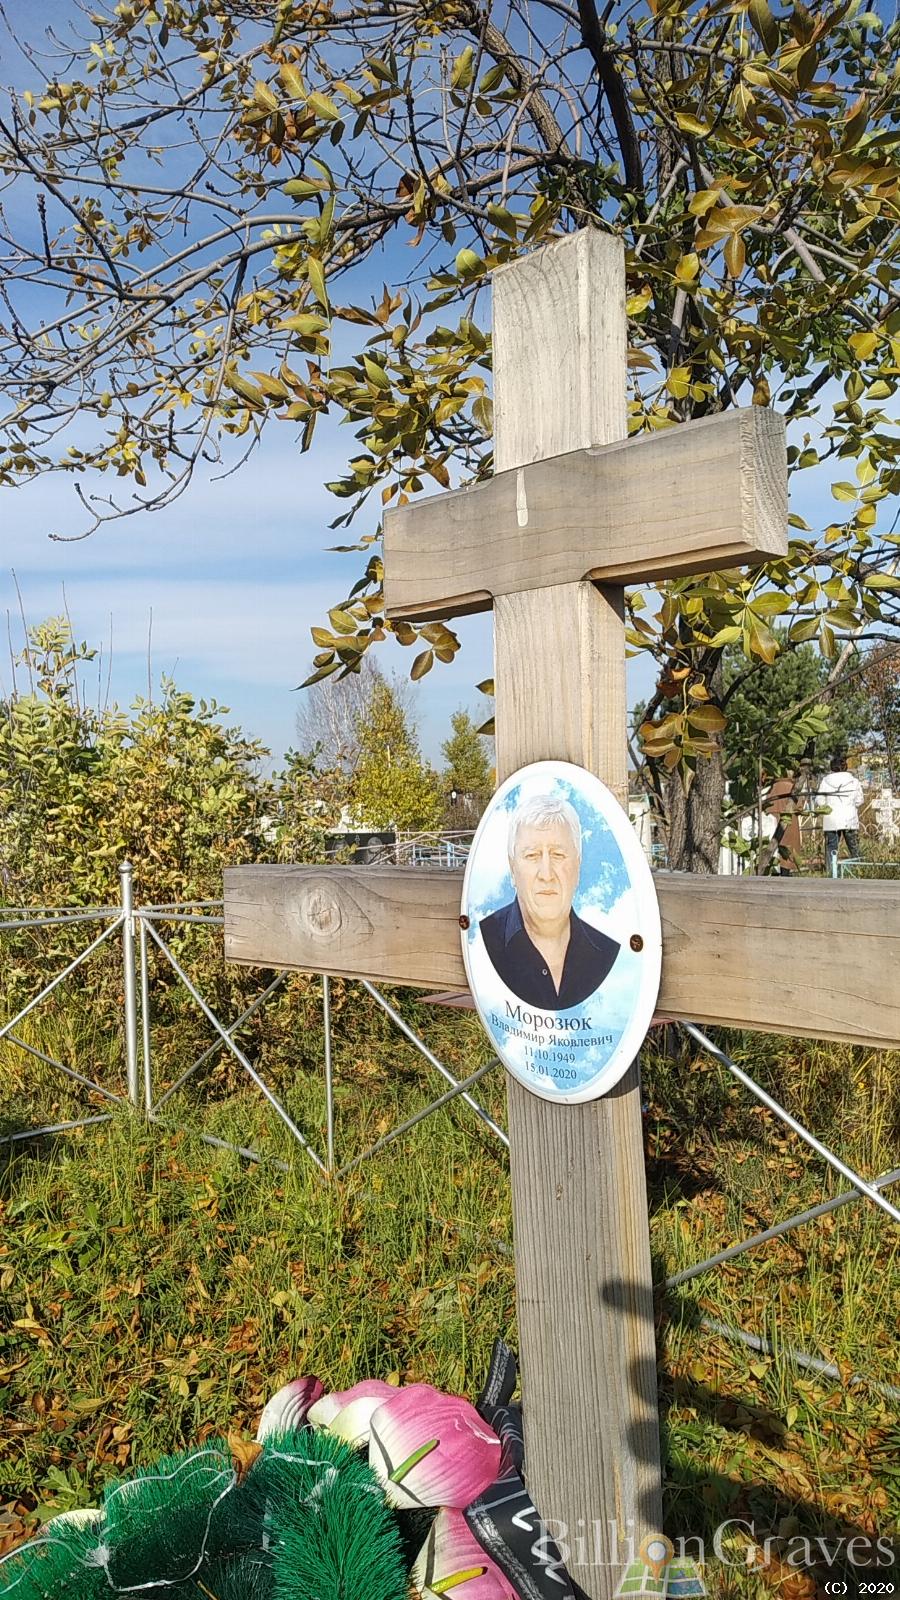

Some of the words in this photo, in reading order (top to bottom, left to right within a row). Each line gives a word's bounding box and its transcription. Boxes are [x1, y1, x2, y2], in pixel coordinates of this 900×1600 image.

[504, 999, 592, 1031] Морозюк
[491, 1012, 545, 1046] Владимир
[549, 1034, 613, 1048] Яковлевич
[524, 1046, 576, 1063] 11.10.1949
[525, 1062, 577, 1080] 15.01.2020
